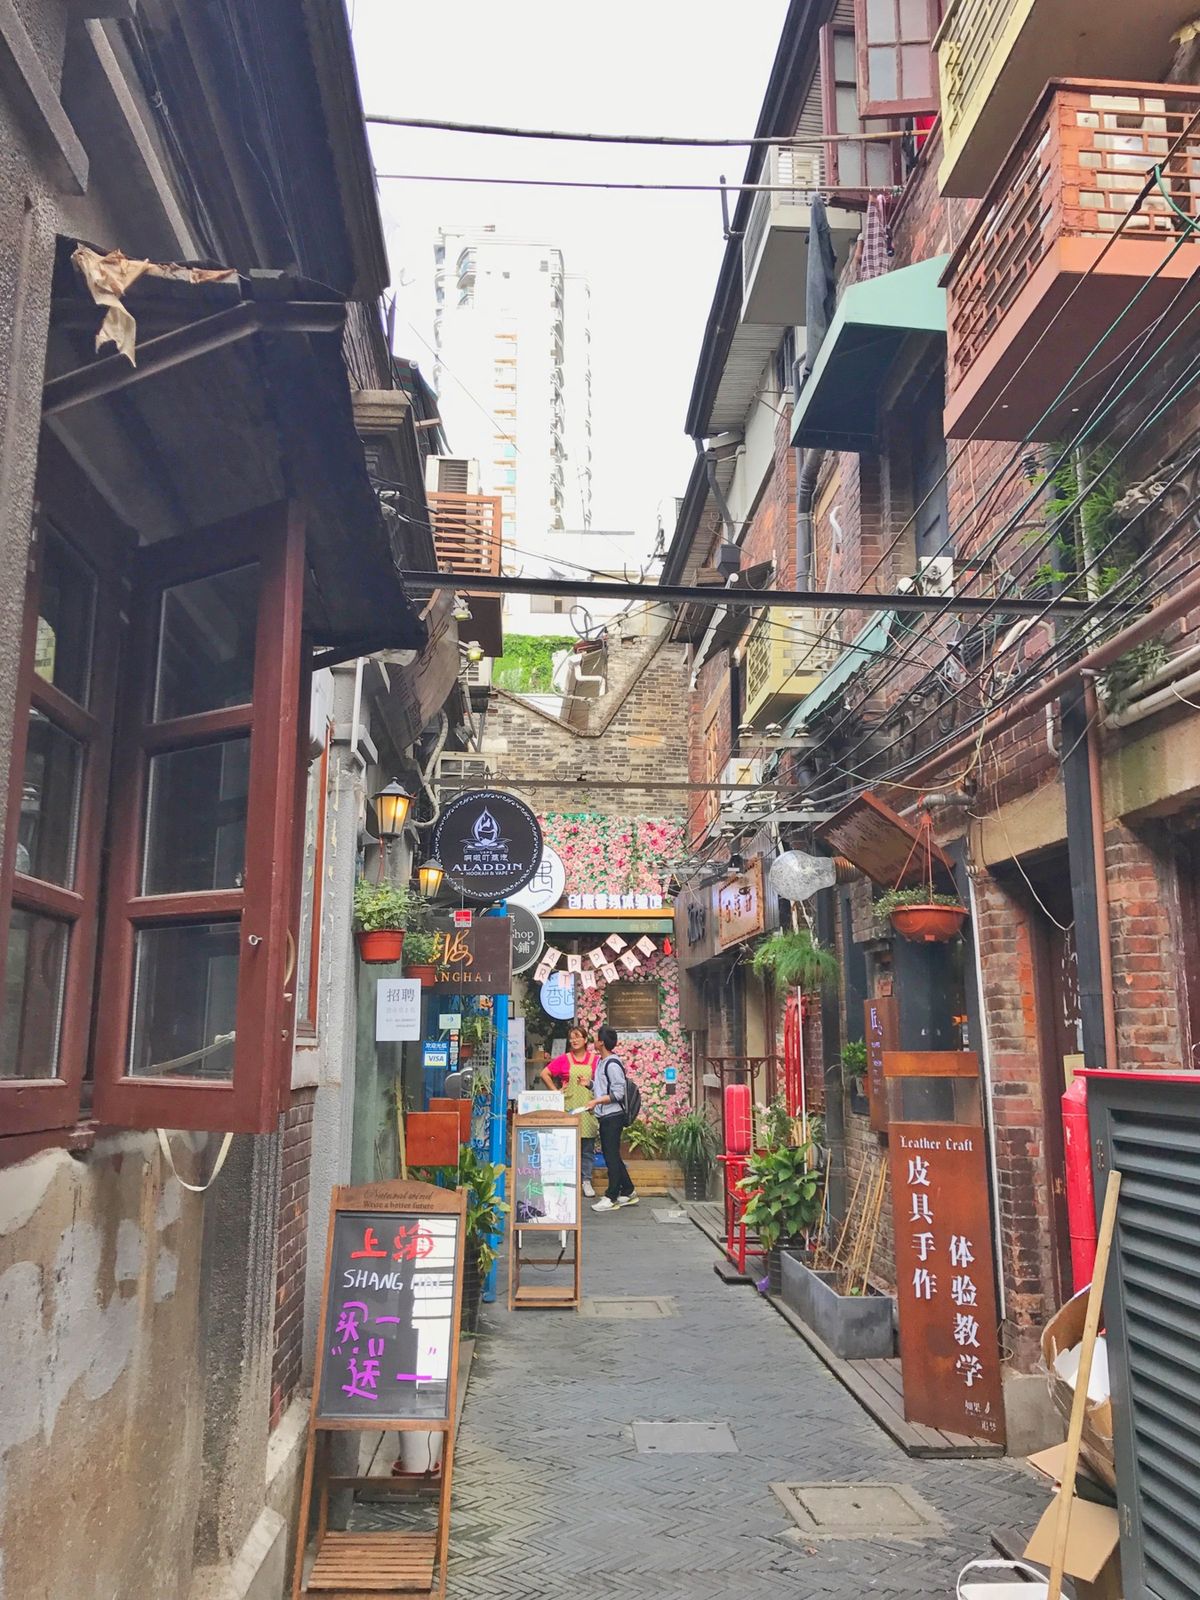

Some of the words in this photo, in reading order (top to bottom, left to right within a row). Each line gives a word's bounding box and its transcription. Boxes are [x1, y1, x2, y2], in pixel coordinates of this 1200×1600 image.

[452, 863, 523, 871] ALADDIN
[387, 988, 415, 1002] 招聘
[900, 1136, 941, 1149] Leather
[946, 1138, 973, 1151] Craft
[907, 1155, 937, 1300] 皮具手作
[350, 1224, 435, 1261] 上海
[343, 1269, 404, 1291] SHANG
[949, 1235, 983, 1387] 体验教学
